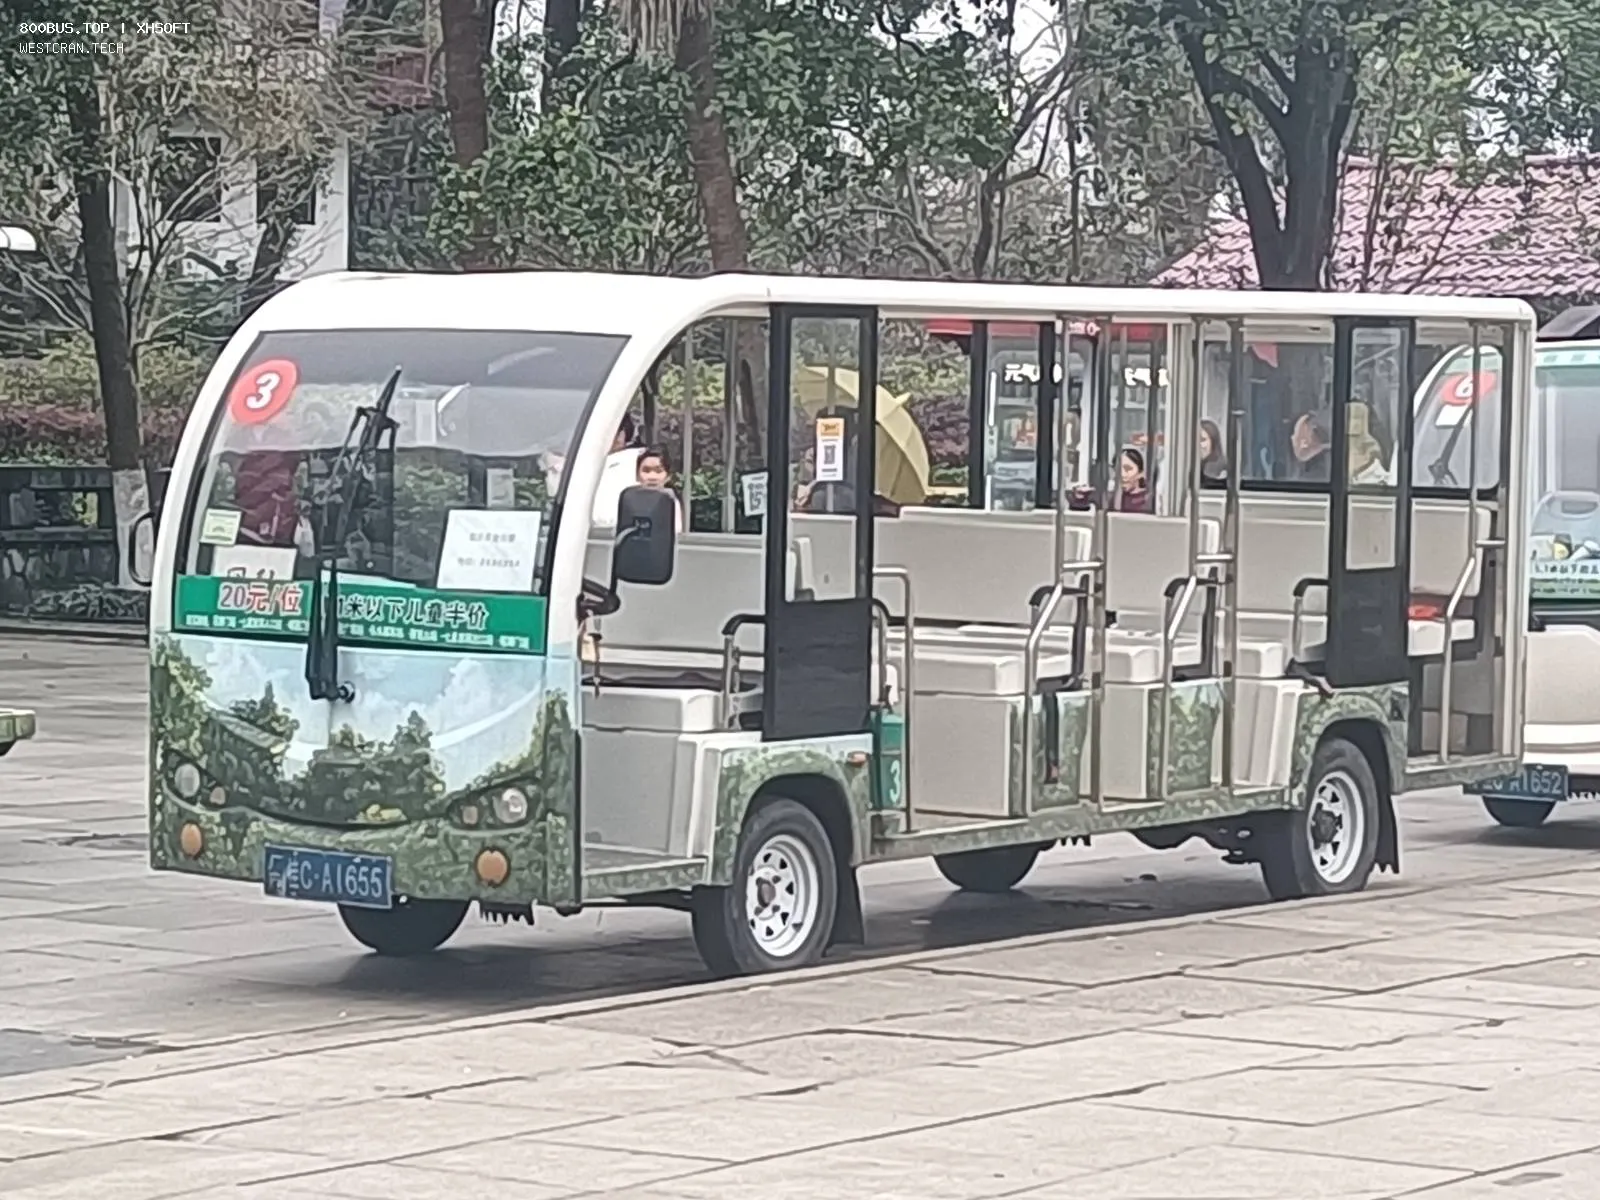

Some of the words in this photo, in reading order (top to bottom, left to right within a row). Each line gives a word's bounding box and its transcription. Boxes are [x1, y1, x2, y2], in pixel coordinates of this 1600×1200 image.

[247, 373, 281, 409] 3
[218, 582, 302, 615] 20元/位
[889, 760, 901, 803] 3
